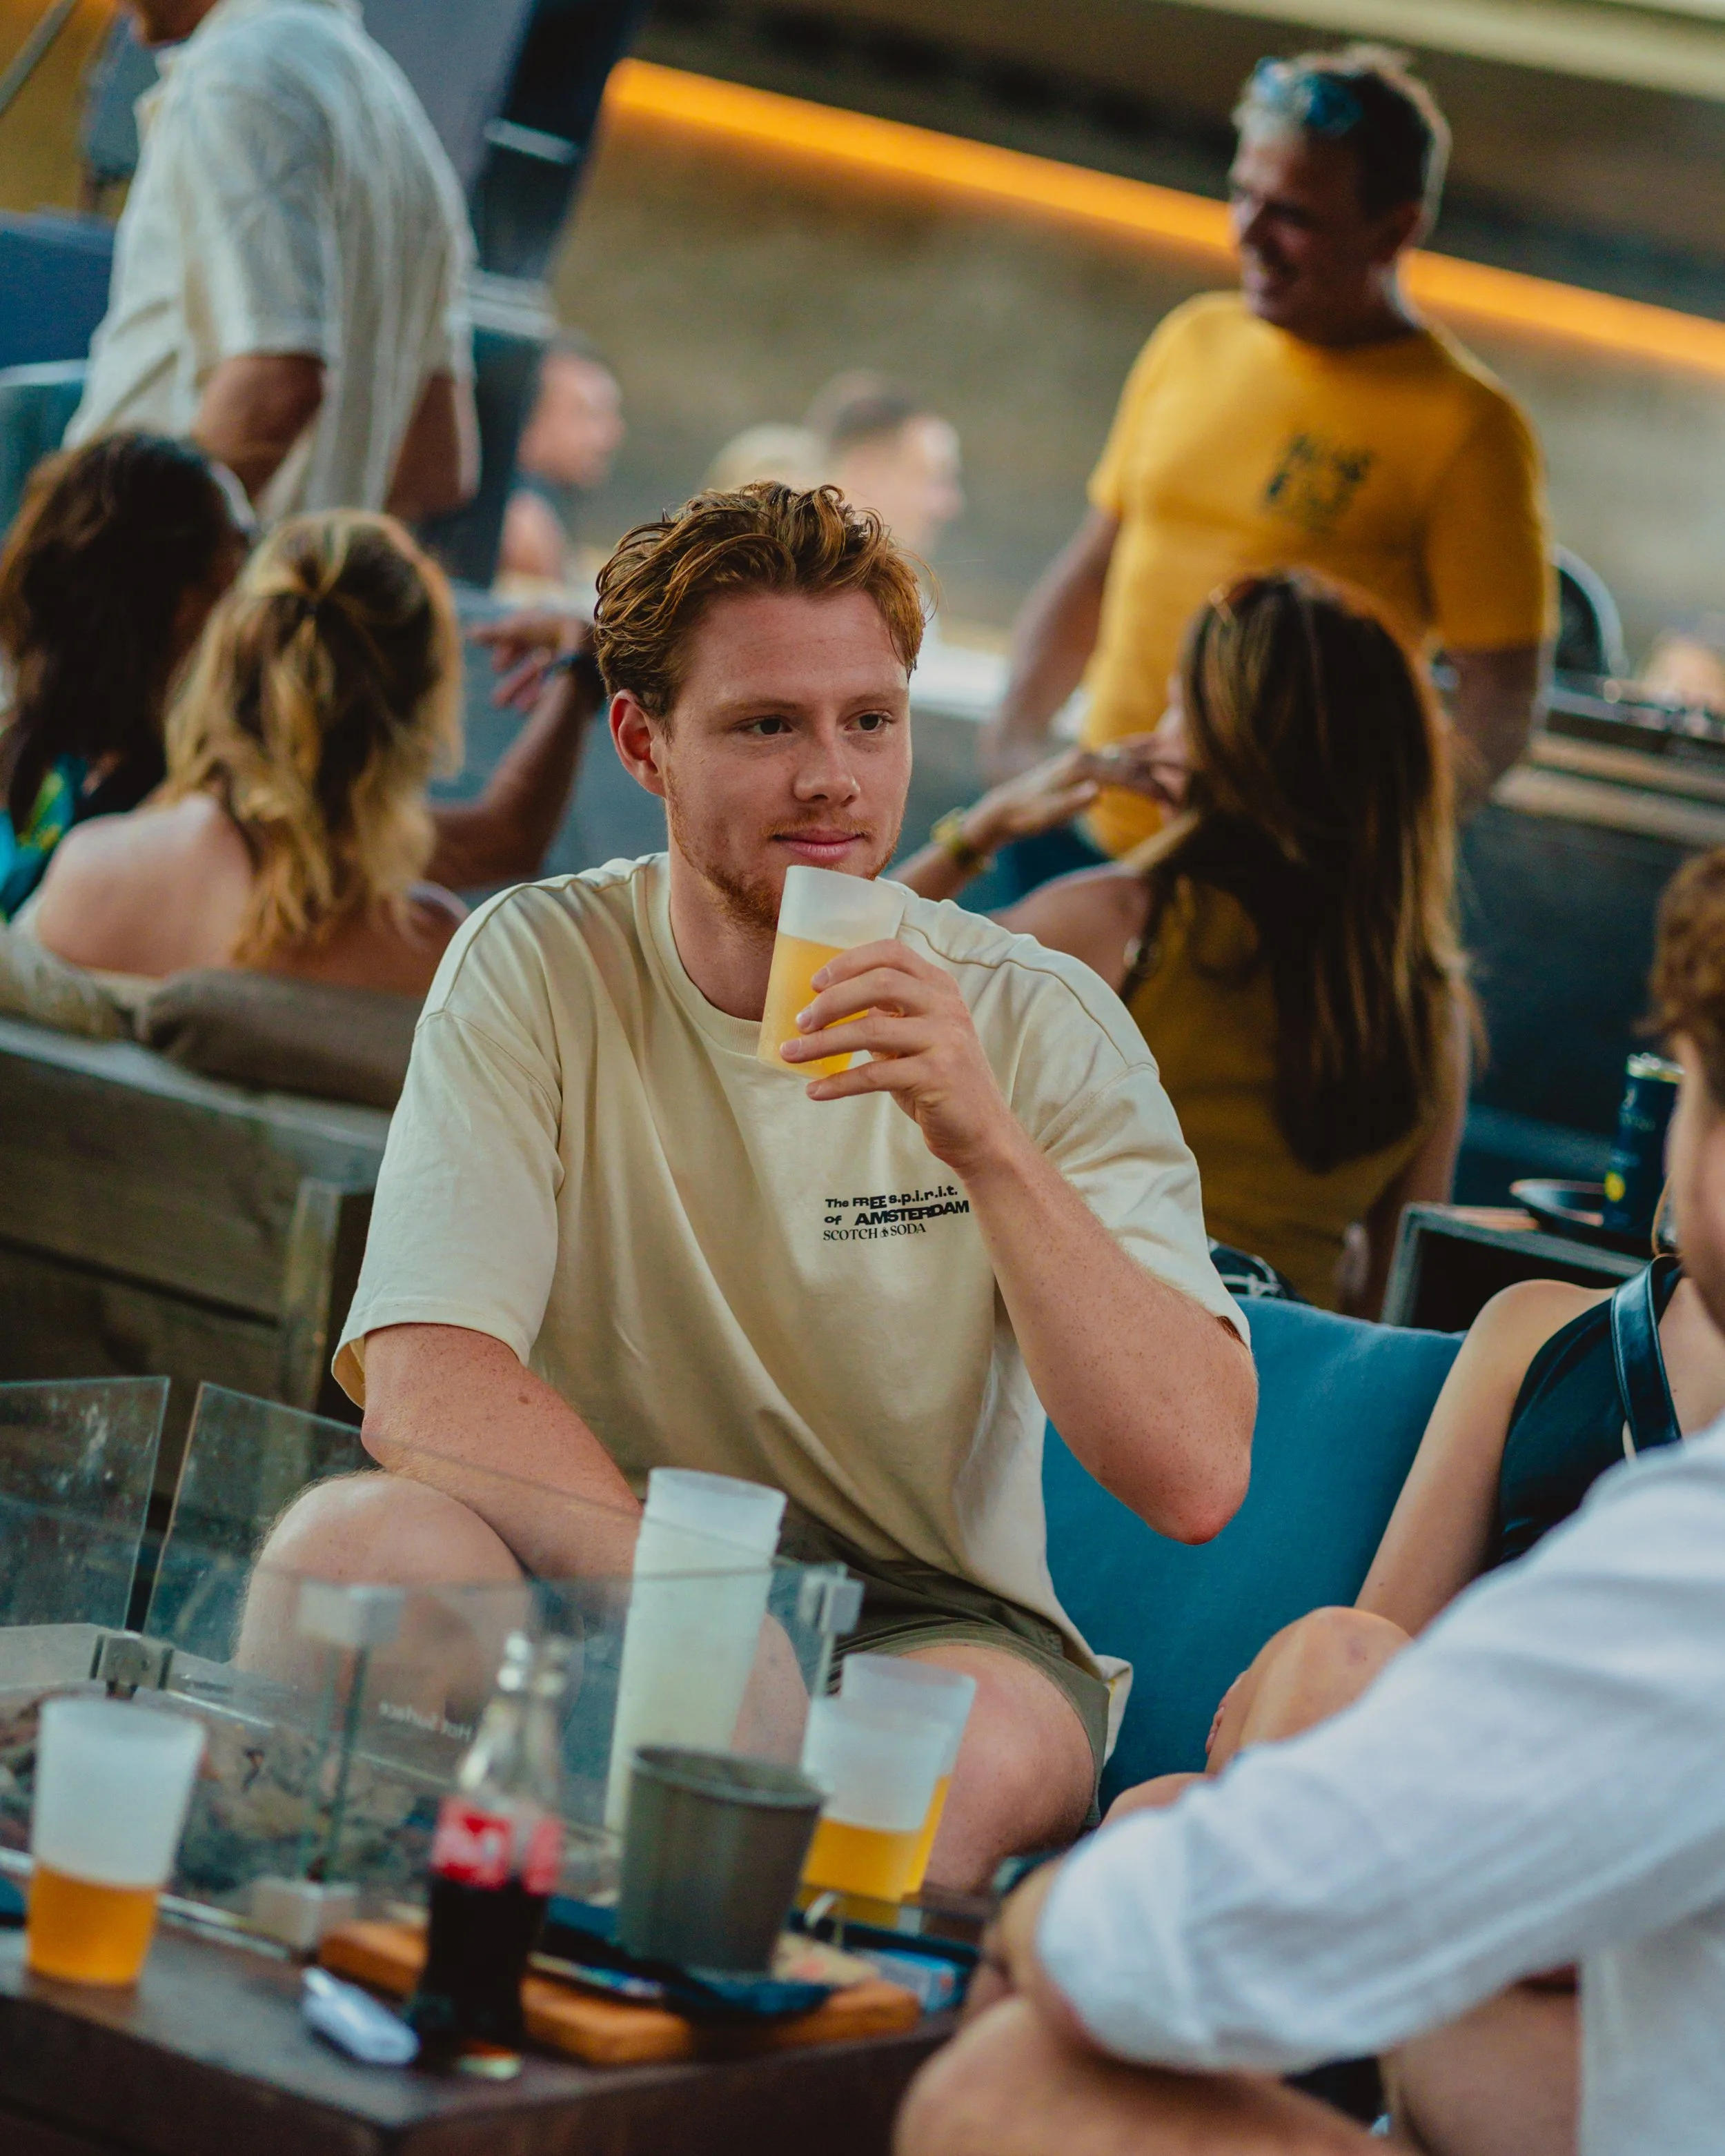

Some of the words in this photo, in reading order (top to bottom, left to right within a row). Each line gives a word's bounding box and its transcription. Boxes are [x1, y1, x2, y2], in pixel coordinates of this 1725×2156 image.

[825, 1198, 849, 1207] The
[853, 1196, 887, 1209] FREE
[824, 1215, 842, 1225] of
[854, 1200, 969, 1225] AMSTERDAM
[823, 1228, 878, 1240] SCOTCH
[890, 1223, 926, 1236] SODA
